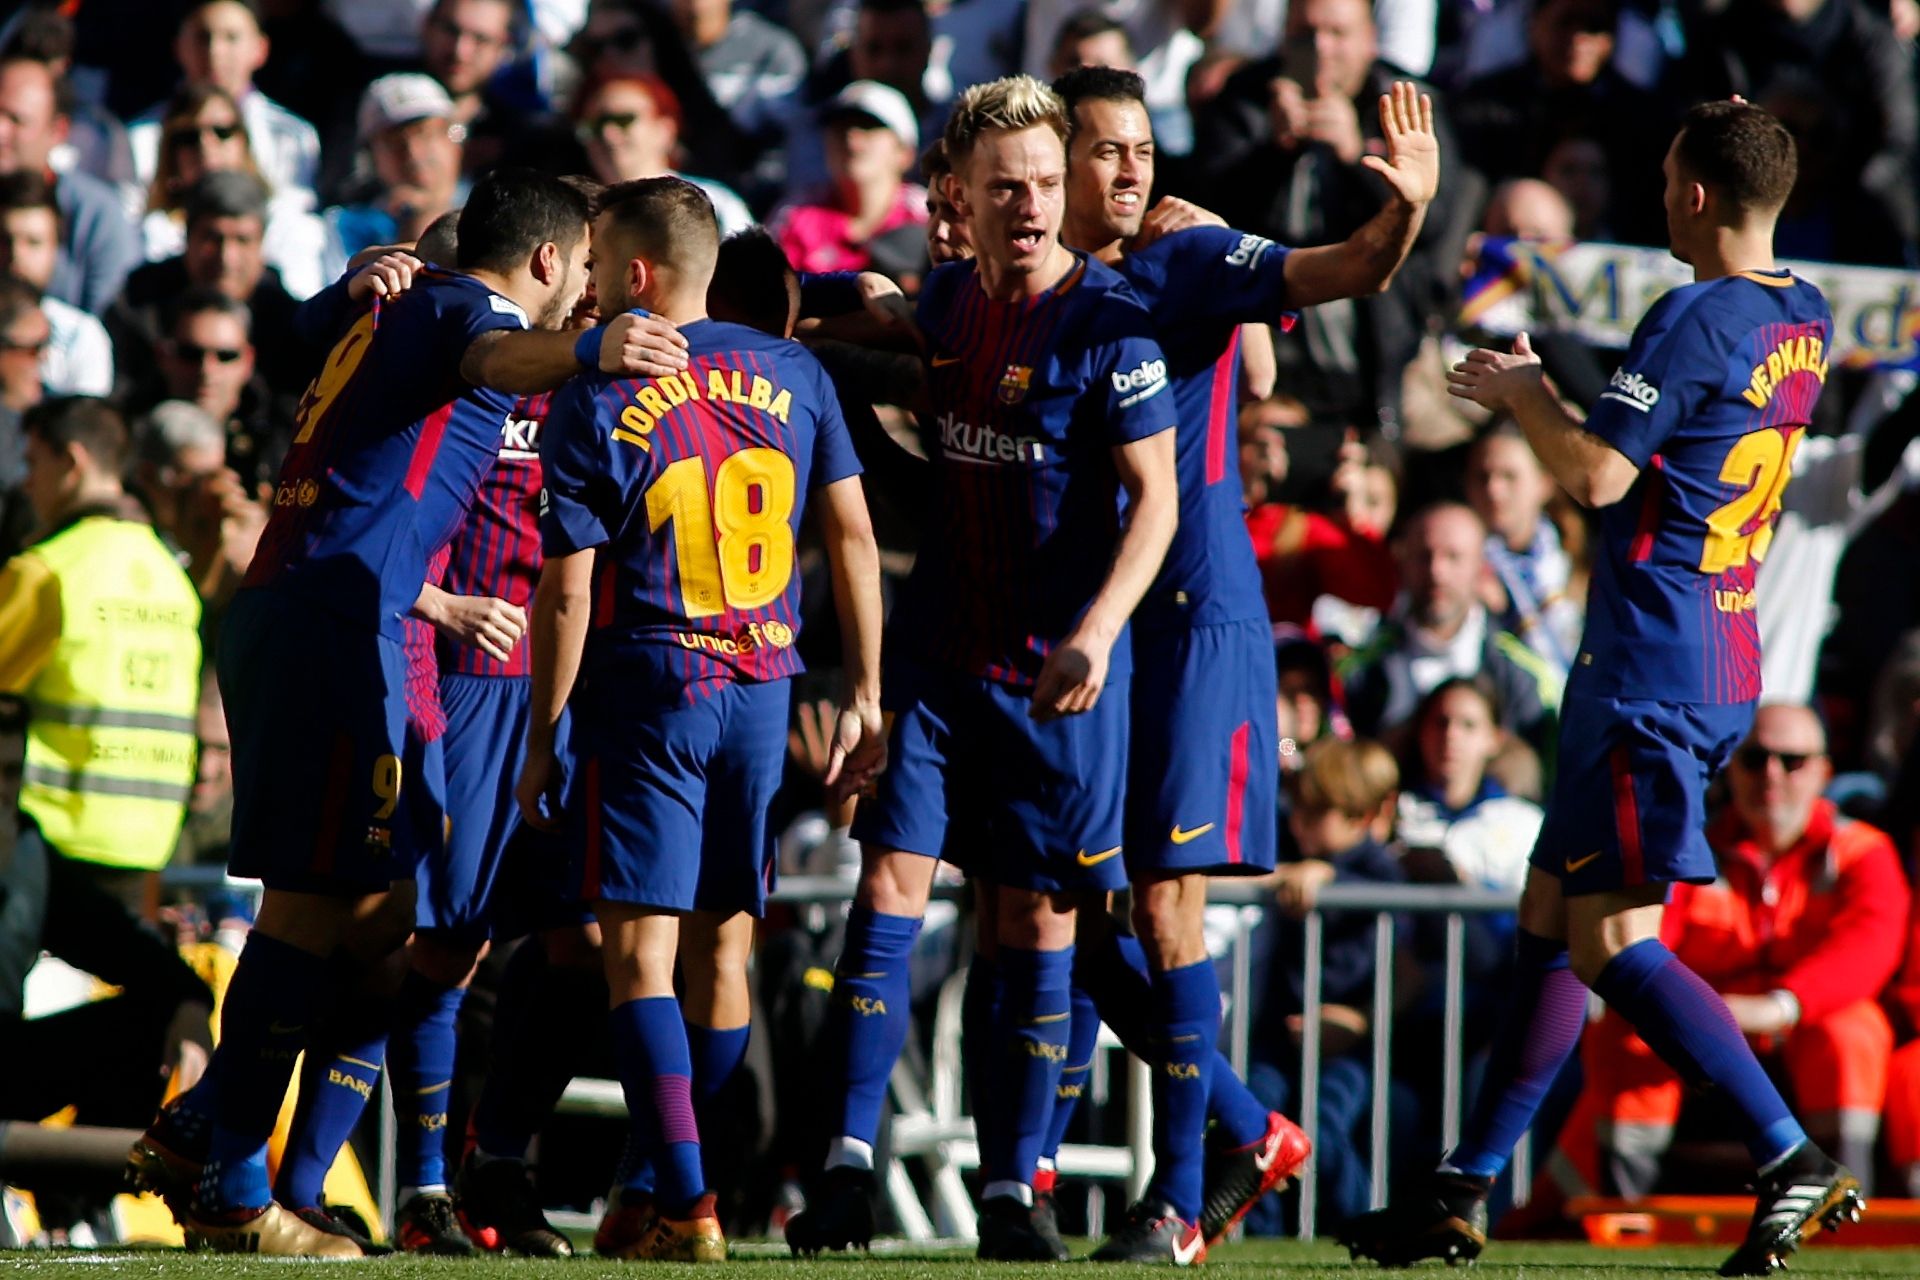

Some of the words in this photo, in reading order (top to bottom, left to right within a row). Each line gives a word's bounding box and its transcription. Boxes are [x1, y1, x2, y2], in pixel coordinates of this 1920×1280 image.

[1111, 359, 1167, 392] beko
[1610, 366, 1660, 406] beko
[611, 371, 700, 453] JORDI
[707, 369, 792, 424] ALBA
[644, 447, 796, 619] 18
[679, 622, 764, 655] unicef
[372, 753, 402, 820] 9
